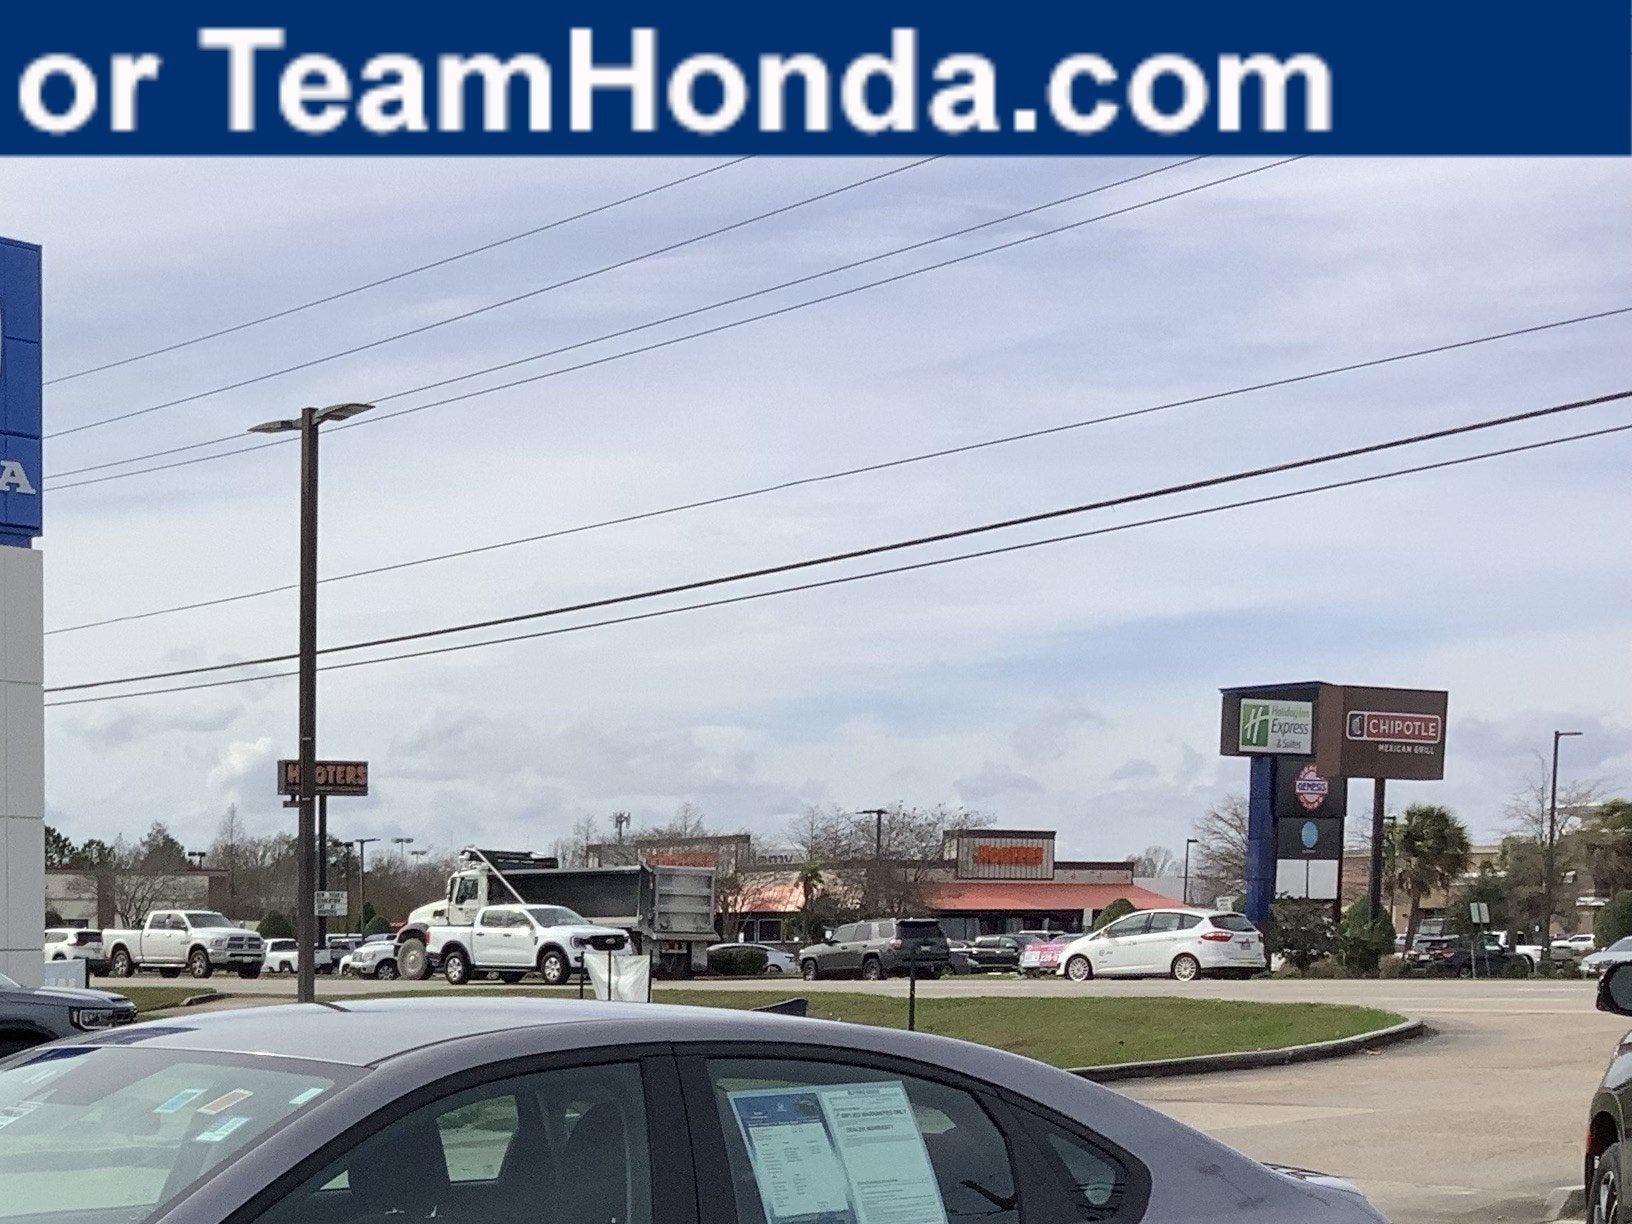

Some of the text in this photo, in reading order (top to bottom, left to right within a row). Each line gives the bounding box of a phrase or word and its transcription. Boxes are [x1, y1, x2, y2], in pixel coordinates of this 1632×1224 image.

[1270, 718, 1309, 738] Express
[1369, 719, 1437, 737] CHIPOTLE
[1378, 744, 1413, 753] MEXICAN
[286, 763, 367, 785] HOTERS
